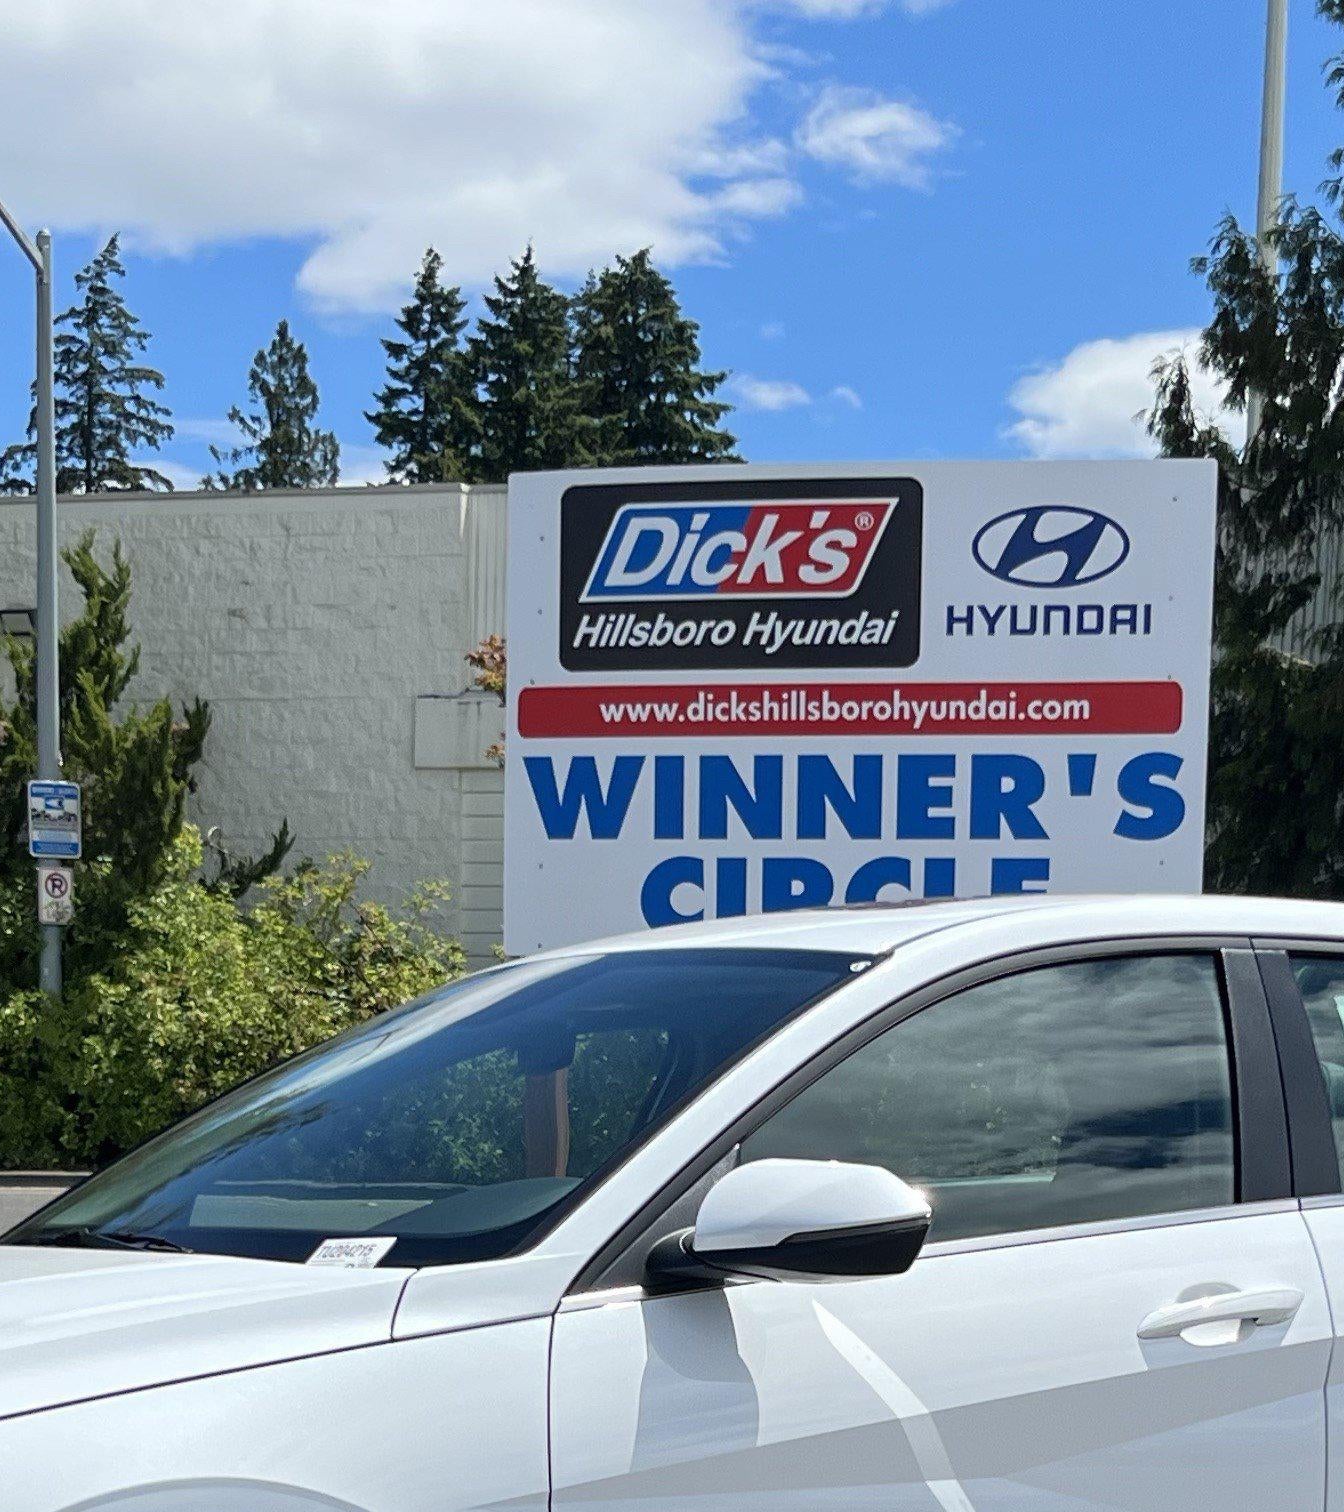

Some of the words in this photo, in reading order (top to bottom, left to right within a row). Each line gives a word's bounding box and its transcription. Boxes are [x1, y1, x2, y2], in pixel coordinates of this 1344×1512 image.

[573, 612, 737, 649] Hillsboro
[743, 610, 900, 655] Hyundai
[946, 603, 1152, 636] HYUNDAI
[599, 691, 1091, 729] www.dickshillsborohyundai.com
[522, 751, 1186, 842] WINNER'S
